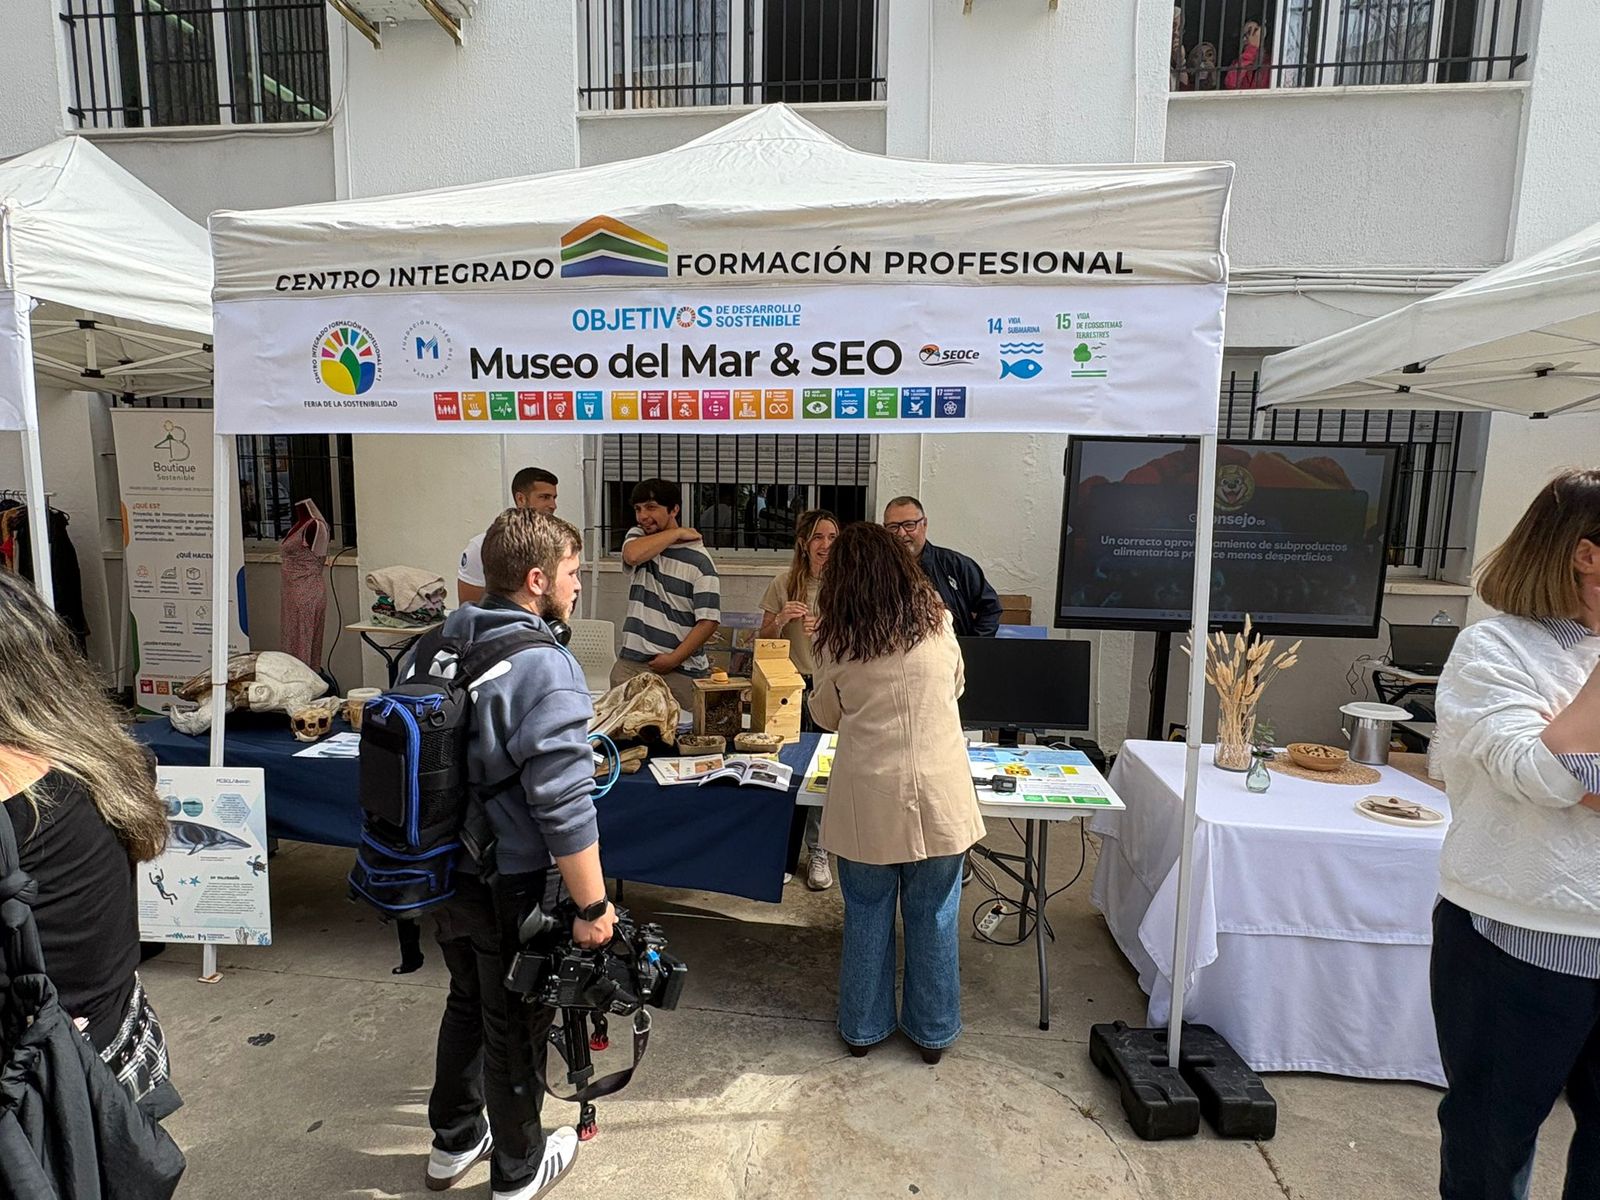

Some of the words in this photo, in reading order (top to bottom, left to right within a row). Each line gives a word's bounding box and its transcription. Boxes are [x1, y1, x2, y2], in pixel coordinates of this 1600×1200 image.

[275, 268, 380, 292] CENTRO
[389, 258, 555, 287] INTEGRADO
[677, 245, 872, 277] FORMACIÓN
[884, 250, 1134, 276] PROFESIONAL
[715, 304, 731, 315] DE
[732, 303, 801, 315] DESARROLLO
[1076, 311, 1091, 320] VIDA
[571, 304, 713, 332] OBJETIVOS
[715, 313, 801, 328] SOSTENIBLE
[1007, 316, 1021, 325] VIDA
[1055, 313, 1072, 331] 15
[1076, 321, 1084, 330] DE
[1085, 320, 1124, 329] ECOSISTEMAS
[987, 317, 1003, 335] 14
[1007, 325, 1041, 335] SUBMARINA
[311, 327, 329, 358] INTEGRADO
[328, 320, 362, 332] FORMACIÓN
[1076, 330, 1110, 339] TERRESTRES
[469, 346, 599, 381] Museo
[607, 343, 669, 379] del
[682, 342, 760, 378] Mar
[770, 341, 801, 377] &
[811, 339, 903, 376] SEO
[941, 348, 981, 361] SEOCe
[304, 400, 323, 408] FERIA
[323, 400, 333, 408] DE
[333, 400, 343, 408] LA
[343, 400, 398, 408] SOSTENIBILIDAD
[153, 461, 196, 475] Boutique
[156, 473, 195, 481] Sostenible
[1100, 535, 1117, 545] Un
[1117, 536, 1162, 547] correcto
[1164, 537, 1258, 551] aprovamiento
[1258, 539, 1273, 551] de
[1274, 540, 1348, 553] subproductos
[1113, 547, 1180, 559] alimentarios
[1227, 550, 1263, 561] menos
[1265, 550, 1333, 563] desperdicios
